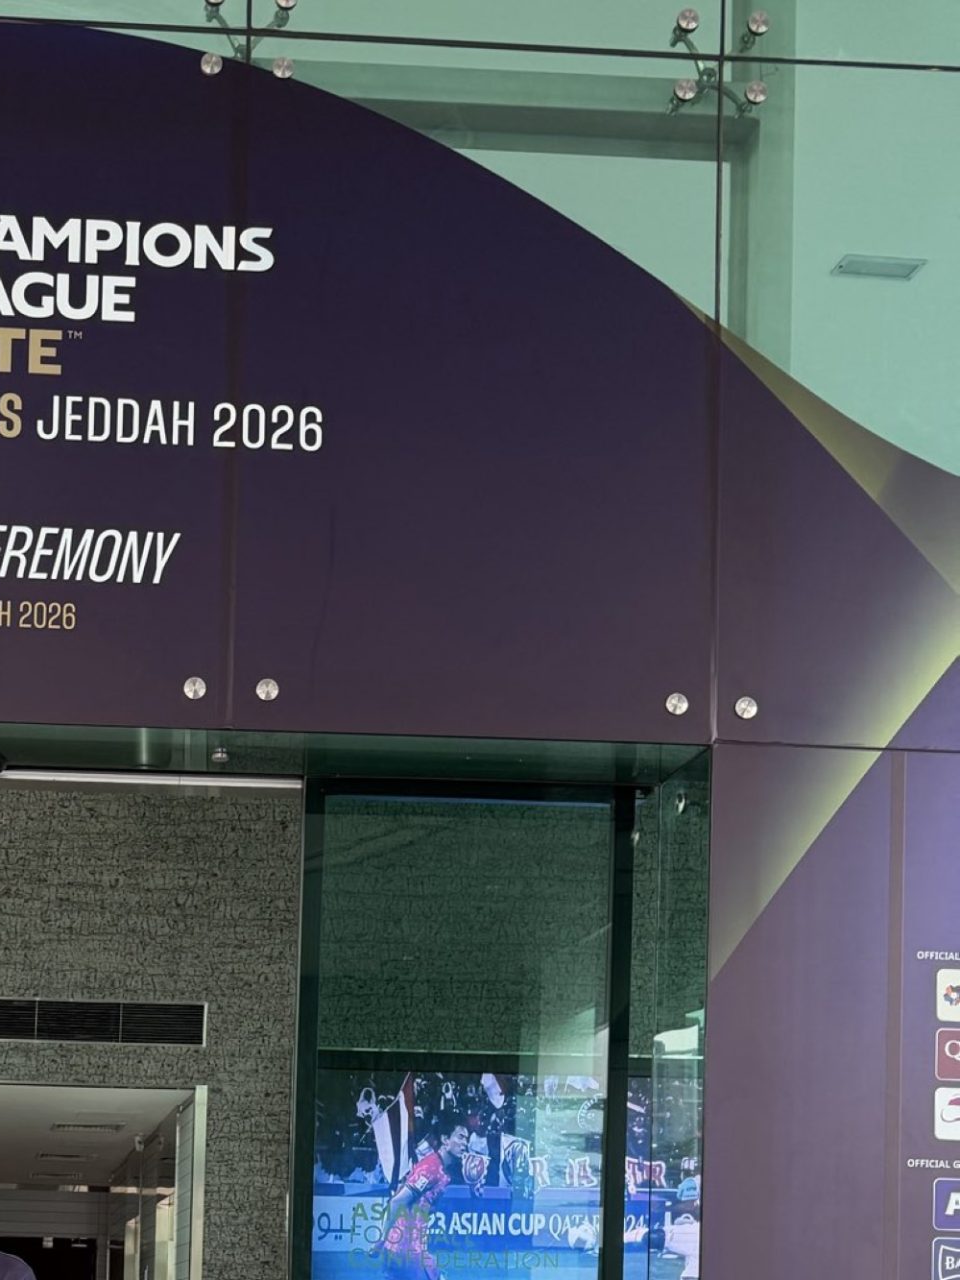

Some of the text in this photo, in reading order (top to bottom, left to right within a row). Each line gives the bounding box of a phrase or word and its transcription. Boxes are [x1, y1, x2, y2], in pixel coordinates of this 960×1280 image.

[36, 394, 195, 447] JEDDAH
[212, 402, 323, 452] 2026
[18, 600, 77, 630] 2026
[916, 950, 960, 961] OFFICIAL
[906, 1158, 951, 1169] OFFICIAL
[447, 1211, 505, 1236] ASIAN
[507, 1212, 546, 1236] CUP
